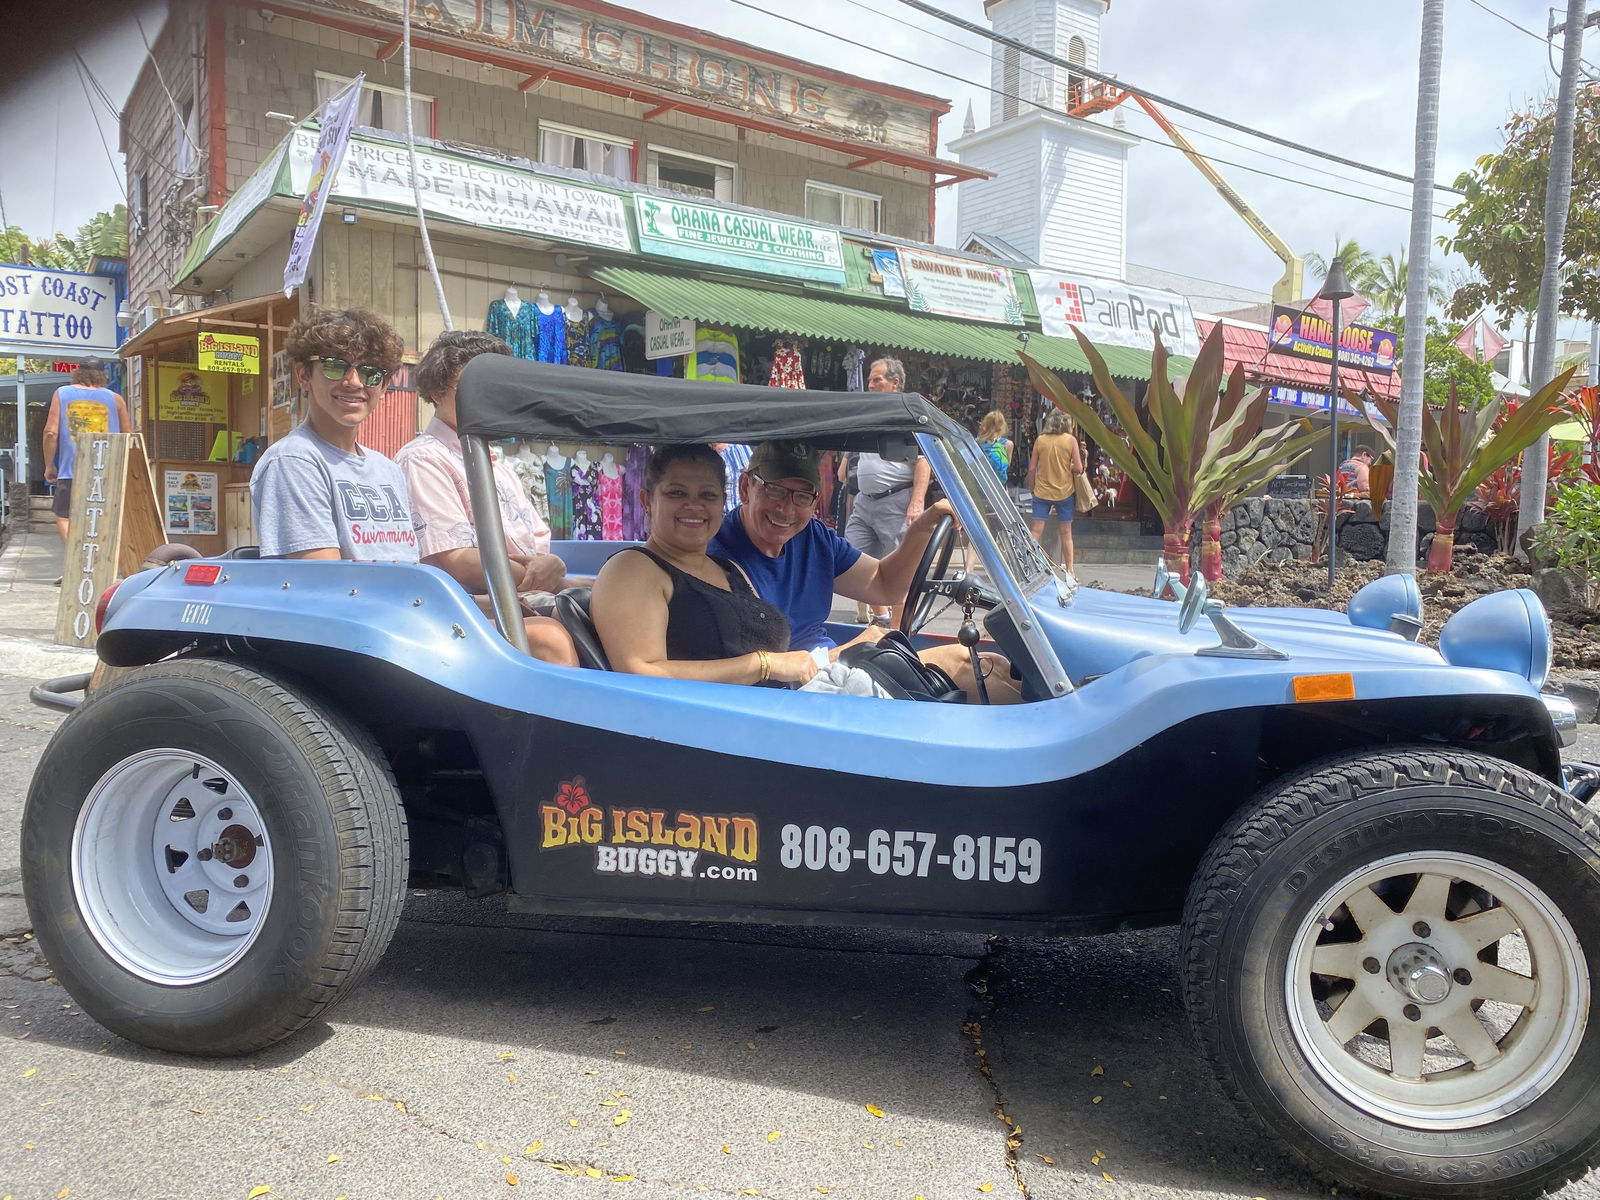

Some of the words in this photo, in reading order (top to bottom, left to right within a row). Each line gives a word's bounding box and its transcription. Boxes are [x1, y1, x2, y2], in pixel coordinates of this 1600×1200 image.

[581, 21, 828, 120] CHONG
[347, 159, 456, 198] MADE
[463, 181, 497, 205] IN
[507, 190, 622, 230] HAWAII
[422, 158, 433, 171] &
[439, 161, 534, 192] SELECTION
[539, 182, 557, 196] IN
[449, 199, 553, 225] HAWAIIAN
[558, 219, 624, 238] SHIRTS
[671, 205, 721, 233] OHANA
[724, 215, 777, 243] CASUAL
[677, 228, 703, 241] FINE
[706, 233, 760, 250] JEWELERY
[761, 242, 772, 252] &
[774, 245, 824, 261] CLOTHING
[911, 258, 963, 279] SAWATDEE
[42, 276, 107, 312] COAST
[1078, 284, 1181, 339] PainPod
[0, 308, 92, 340] TATTOO
[649, 334, 669, 352] CASUAL
[669, 331, 684, 349] WEAR
[214, 360, 245, 368] RENTALS
[1293, 340, 1314, 355] Activity
[335, 479, 410, 522] CCA
[73, 439, 110, 640] TATTOO
[351, 523, 416, 547] Swimming
[780, 823, 1042, 885] 808-657-8159
